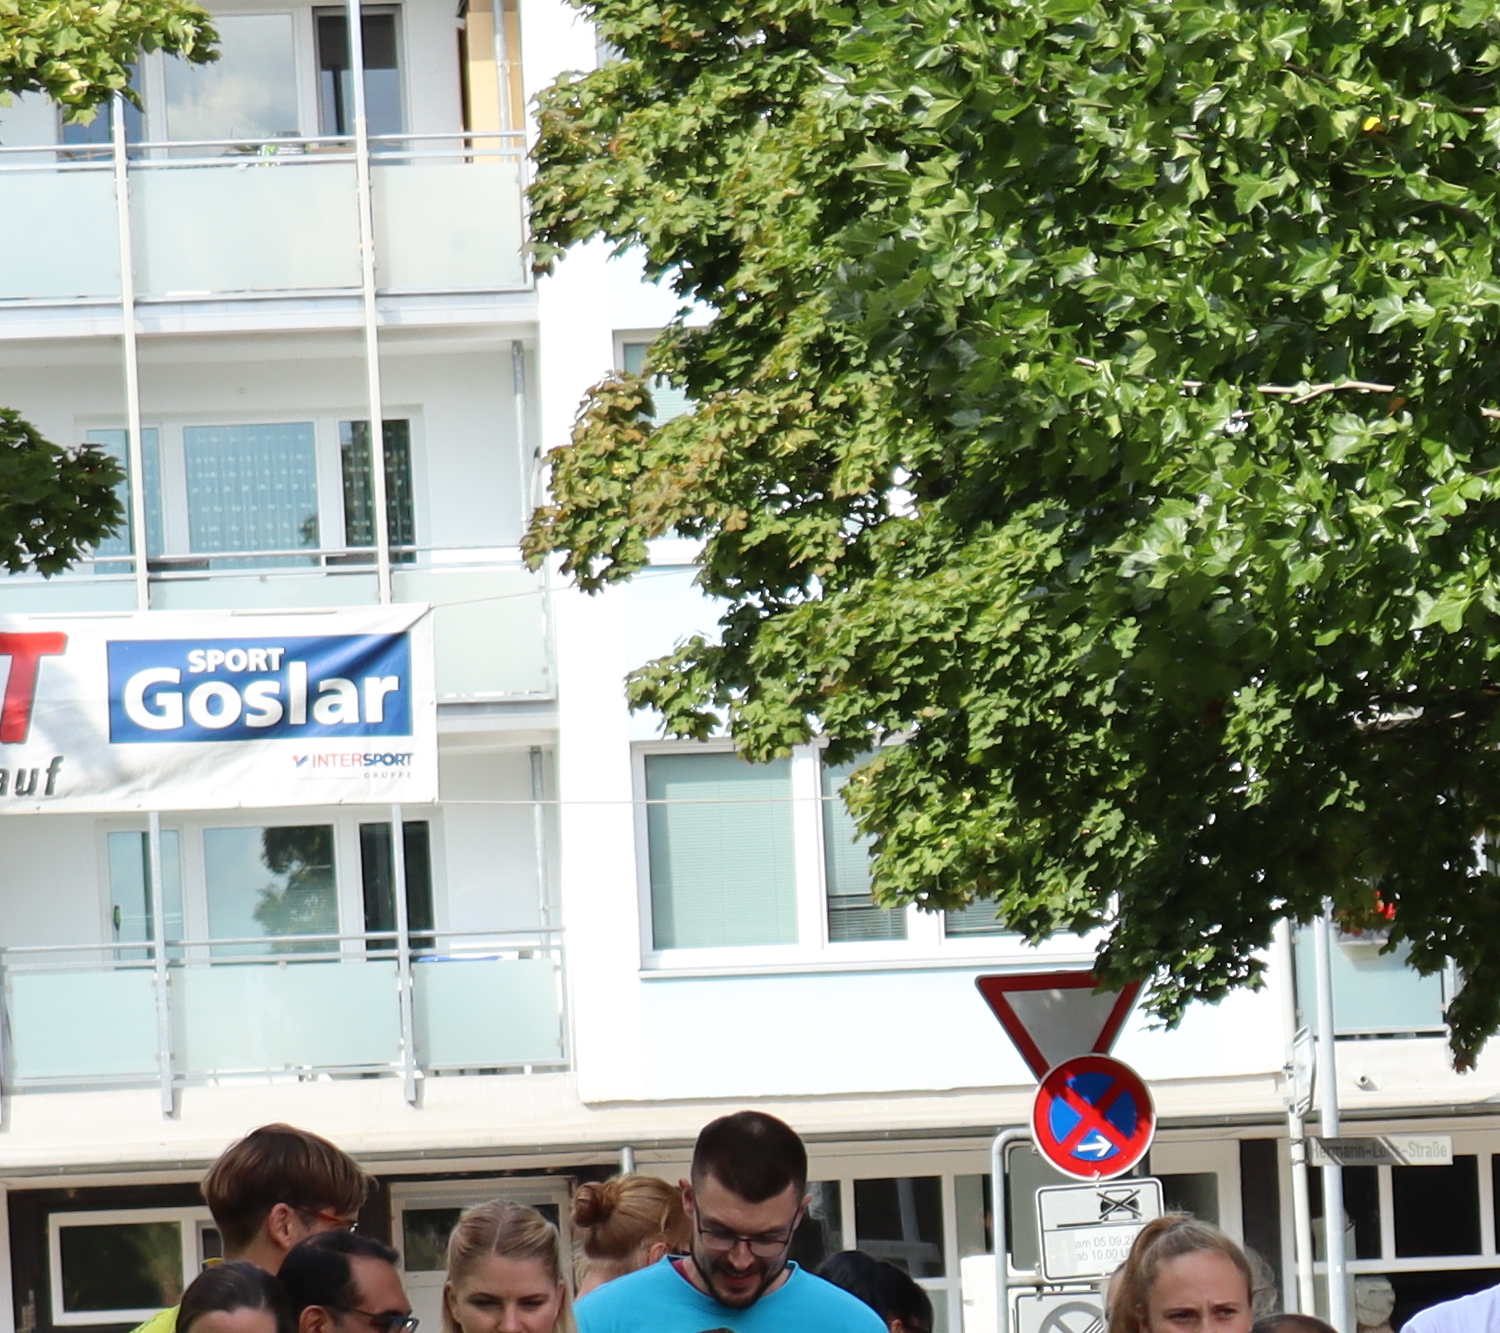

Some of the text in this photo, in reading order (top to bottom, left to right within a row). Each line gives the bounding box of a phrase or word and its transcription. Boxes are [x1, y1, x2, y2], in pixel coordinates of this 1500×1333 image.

[188, 647, 284, 673] SPORT
[124, 661, 399, 730] Goslar
[312, 752, 413, 768] INTERSPORT
[364, 771, 412, 779] GRUPPE
